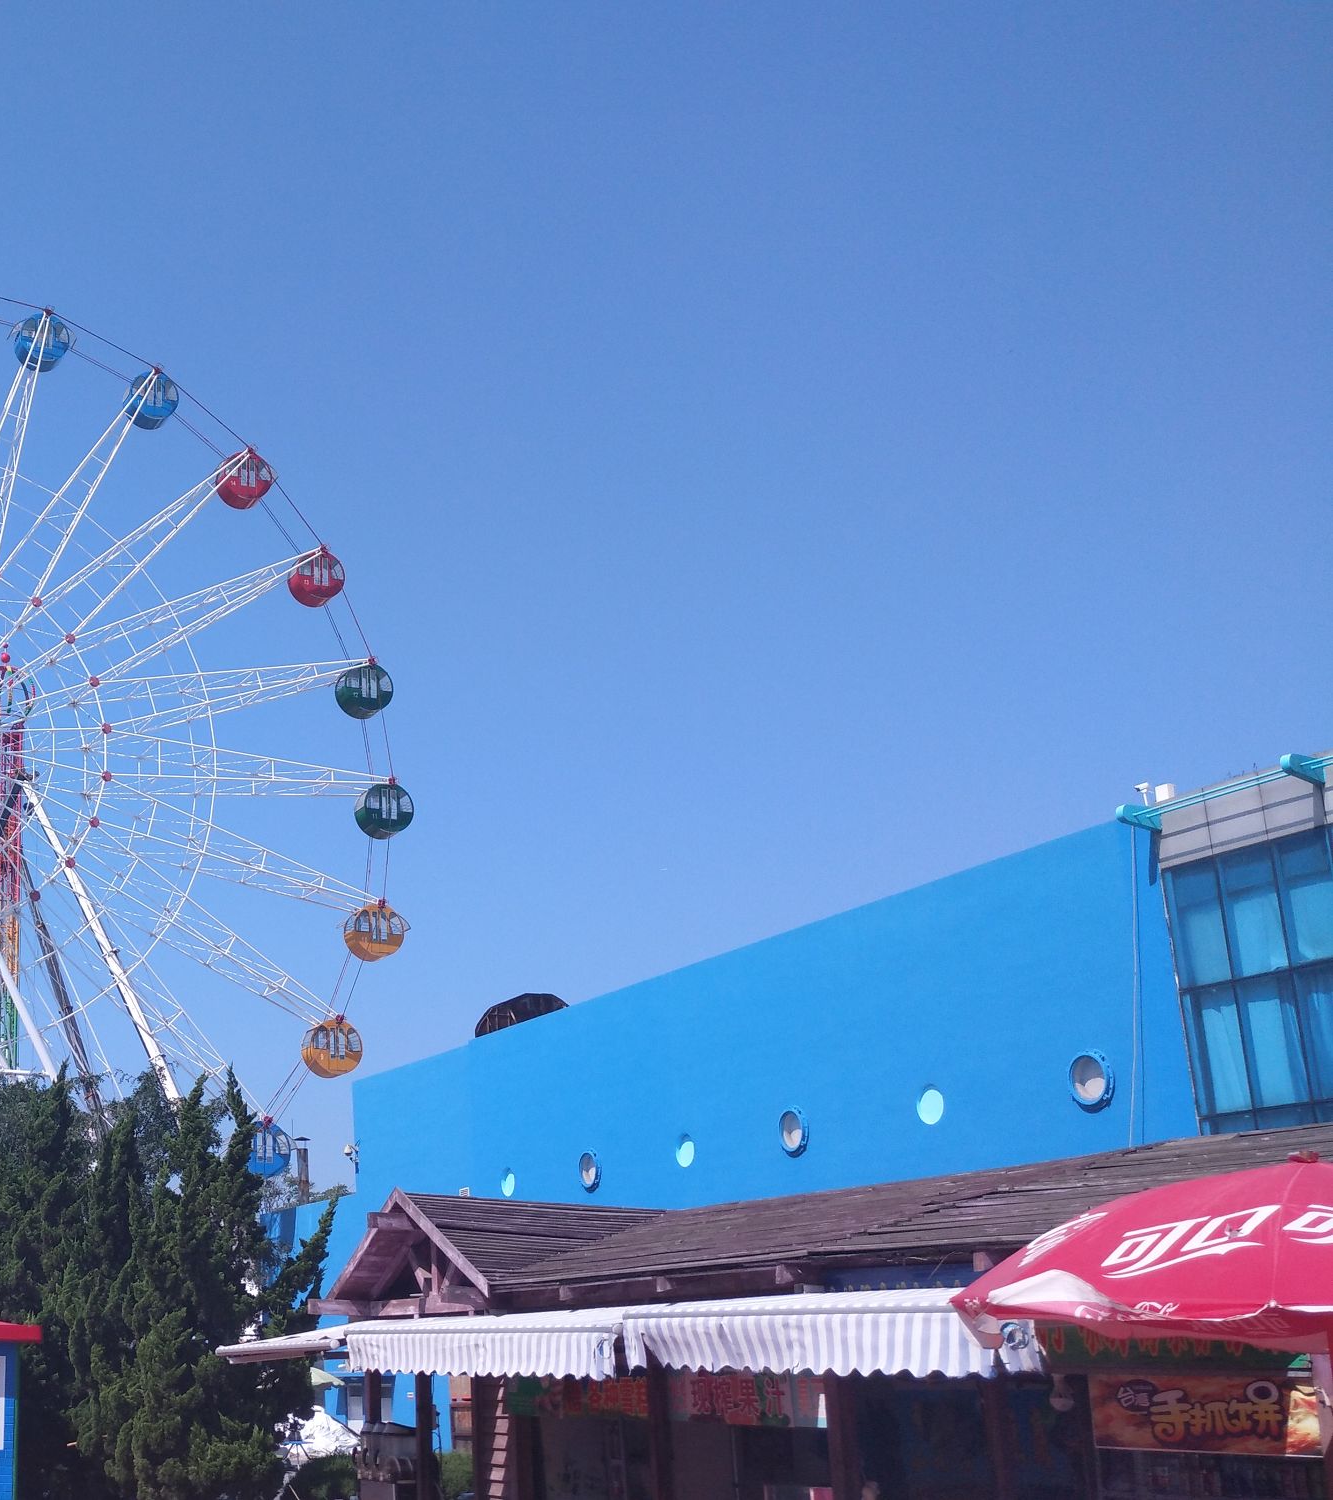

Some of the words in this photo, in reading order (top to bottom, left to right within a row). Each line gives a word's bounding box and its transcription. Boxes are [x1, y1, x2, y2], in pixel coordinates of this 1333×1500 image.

[690, 1376, 786, 1418] 现榨果汁
[1150, 1381, 1284, 1442] 手抓饼
